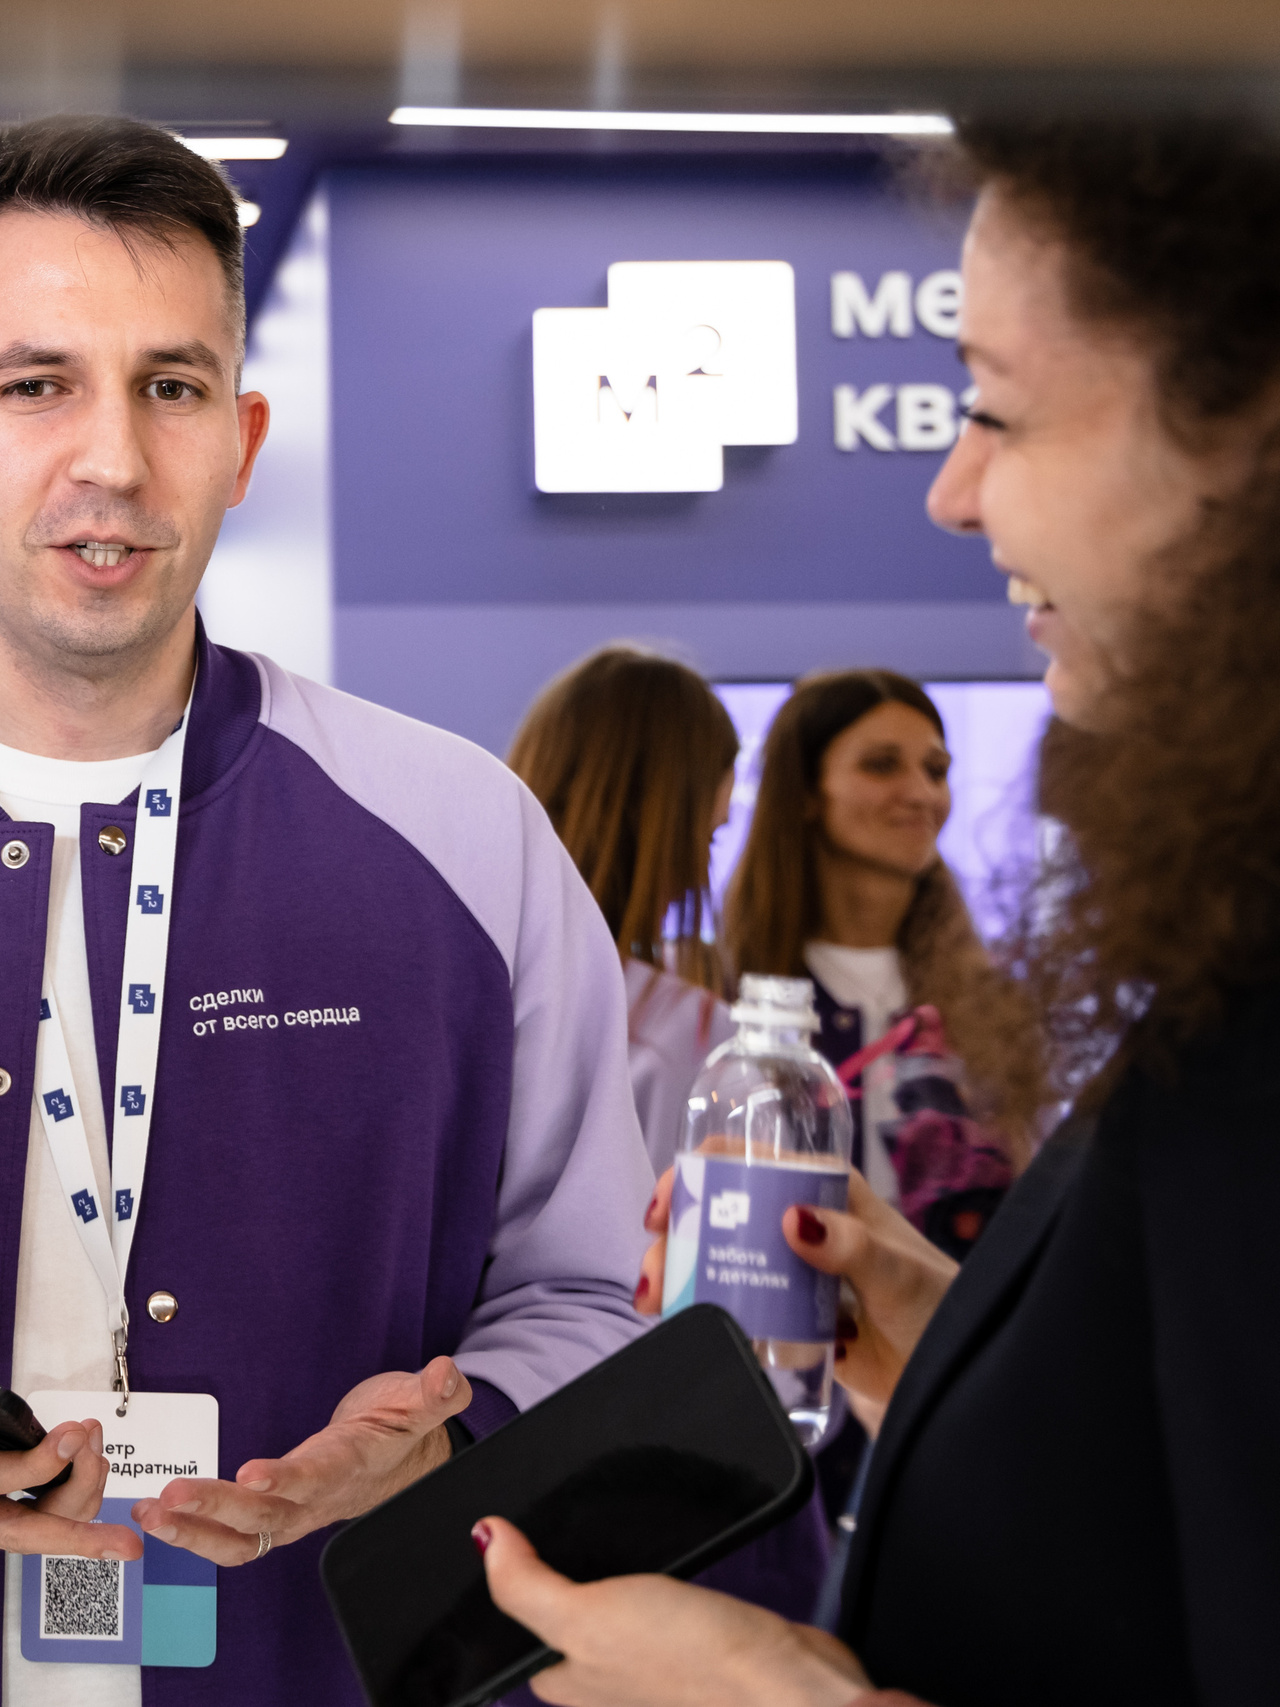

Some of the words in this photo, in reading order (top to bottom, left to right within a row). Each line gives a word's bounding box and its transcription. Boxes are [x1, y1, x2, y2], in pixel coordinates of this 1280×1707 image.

[831, 270, 964, 339] ме
[189, 988, 264, 1012] сделки
[193, 1019, 218, 1036] от
[223, 1014, 279, 1032] всего
[283, 1006, 361, 1028] сердца
[101, 1443, 135, 1459] етр
[111, 1461, 198, 1478] адратный
